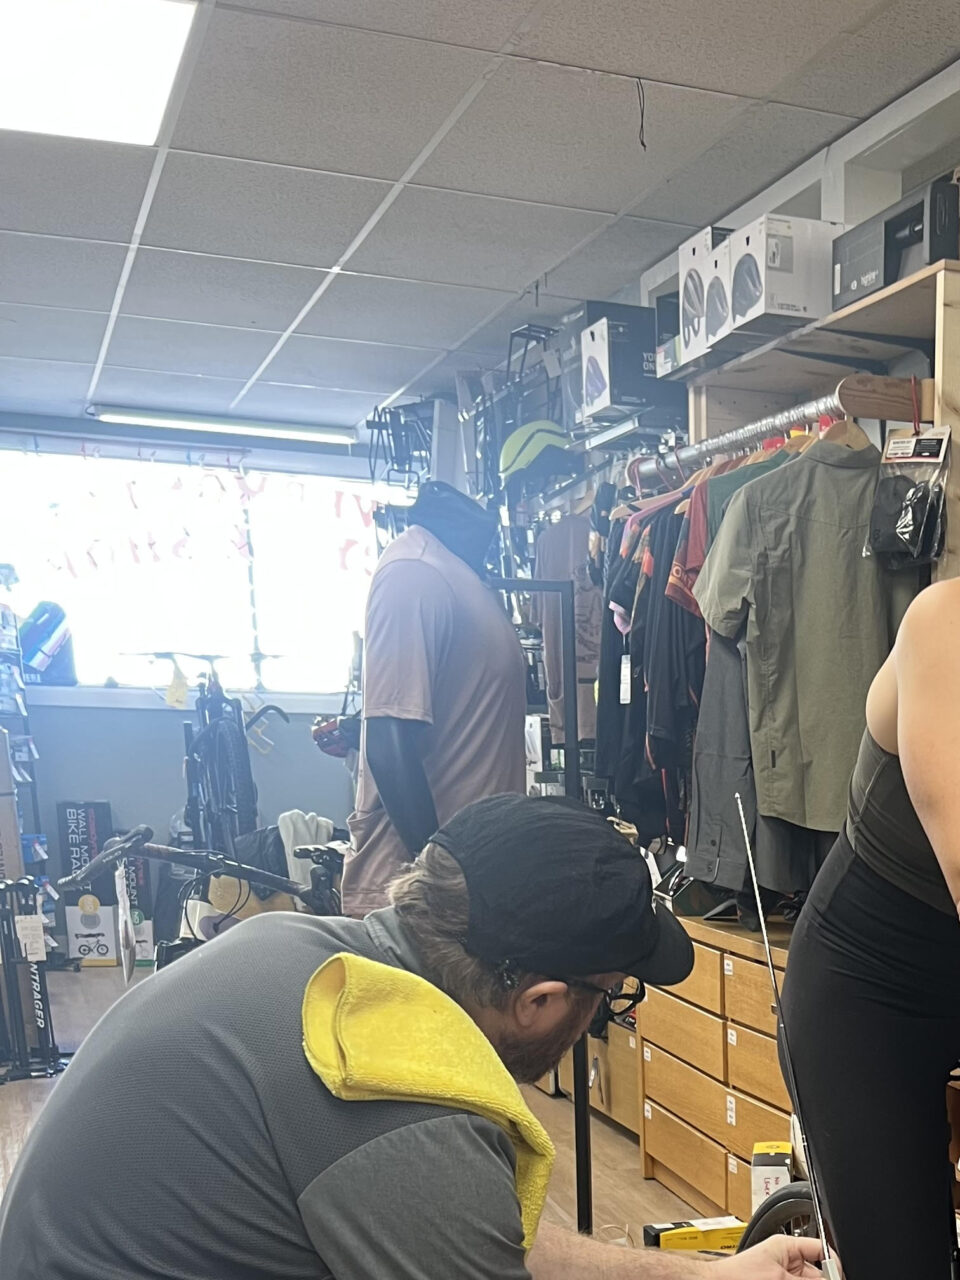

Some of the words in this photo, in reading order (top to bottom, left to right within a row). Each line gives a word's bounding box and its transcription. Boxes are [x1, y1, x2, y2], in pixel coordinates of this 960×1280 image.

[66, 808, 80, 844] BIKE
[78, 808, 88, 843] WALL
[30, 960, 46, 1028] NTRAGER
